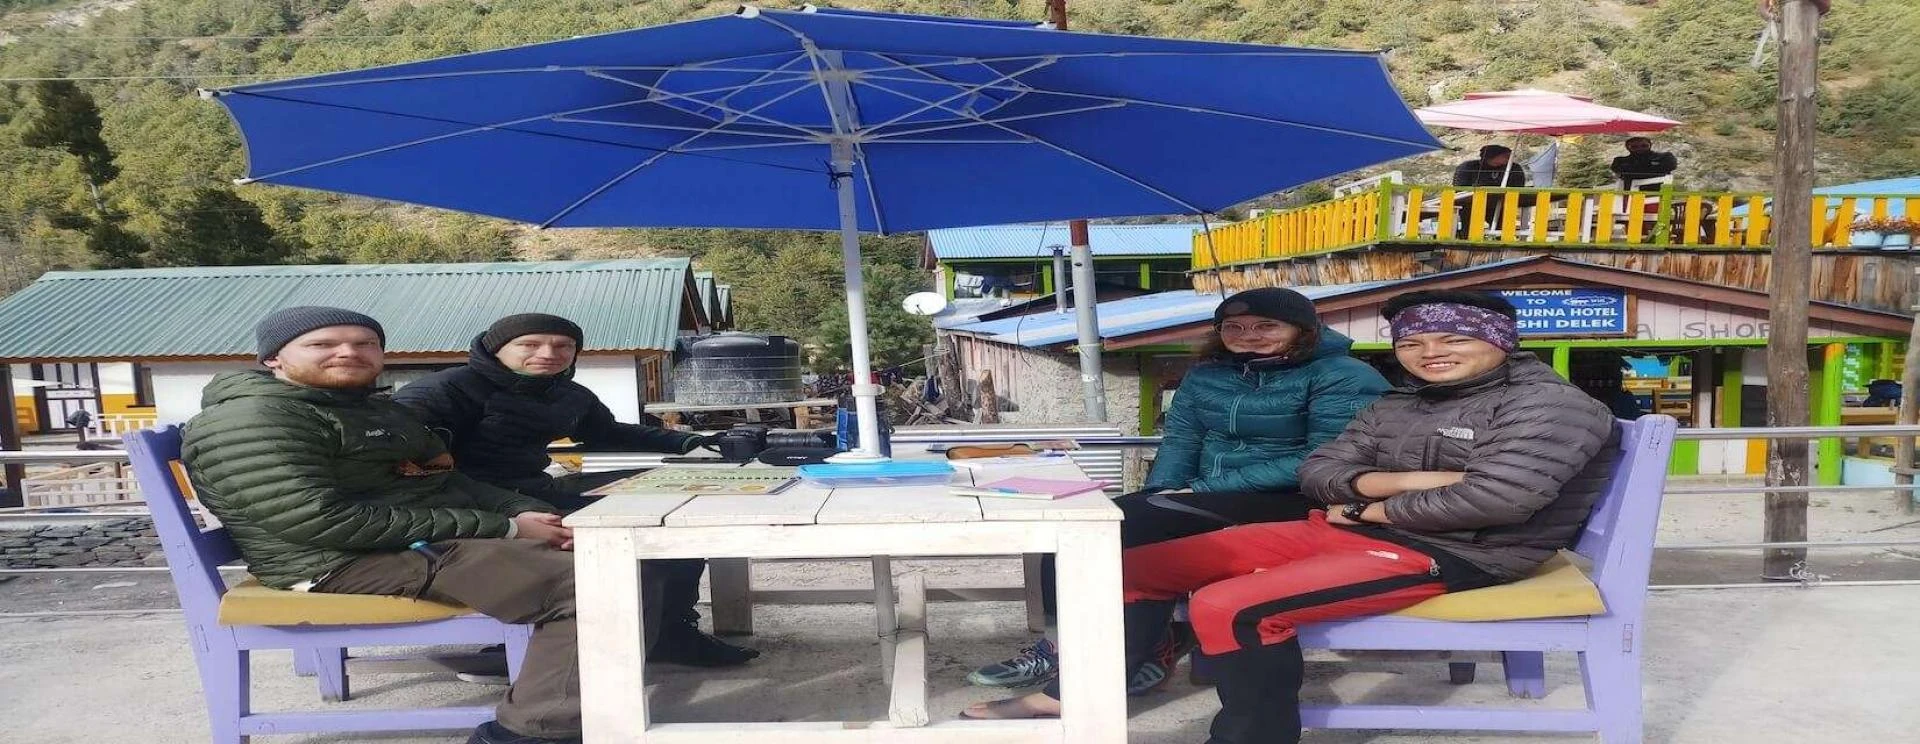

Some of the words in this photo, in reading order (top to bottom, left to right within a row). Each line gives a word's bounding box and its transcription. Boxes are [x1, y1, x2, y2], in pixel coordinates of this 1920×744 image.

[1570, 308, 1618, 316] HOTEL
[1516, 320, 1549, 329] SHI
[1556, 319, 1616, 328] DELEK
